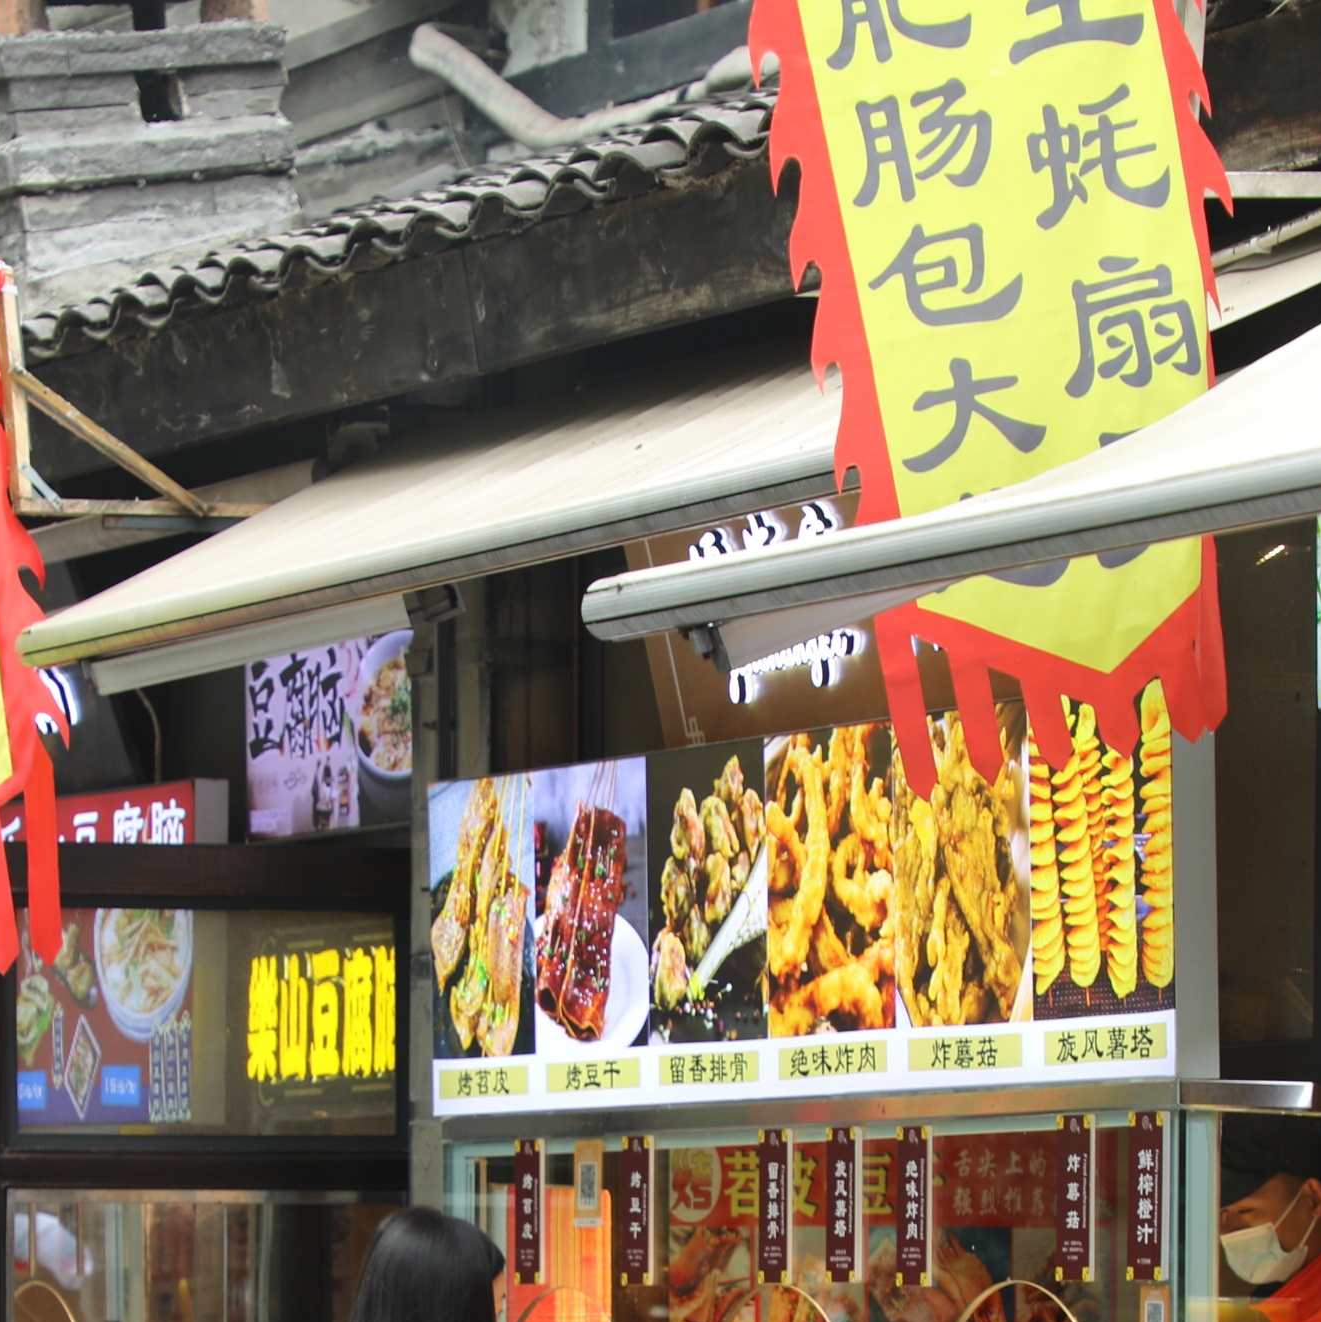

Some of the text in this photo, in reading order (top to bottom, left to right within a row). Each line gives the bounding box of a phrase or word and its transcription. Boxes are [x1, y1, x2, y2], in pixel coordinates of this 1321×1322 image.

[827, 0, 1072, 587] 肥肠包大
[1009, 0, 1201, 568] 蚝扇
[789, 1041, 877, 1077] 绝味炸肉
[931, 1037, 998, 1069] 炸蘑菇
[1057, 1026, 1155, 1063] 旋风薯塔
[457, 1067, 510, 1097] 烤苕皮
[565, 1060, 621, 1089] 烤豆干
[670, 1052, 749, 1084] 留香排骨
[953, 1186, 1057, 1217] 强烈推荐
[1136, 1148, 1155, 1245] 鲜榨橙汁
